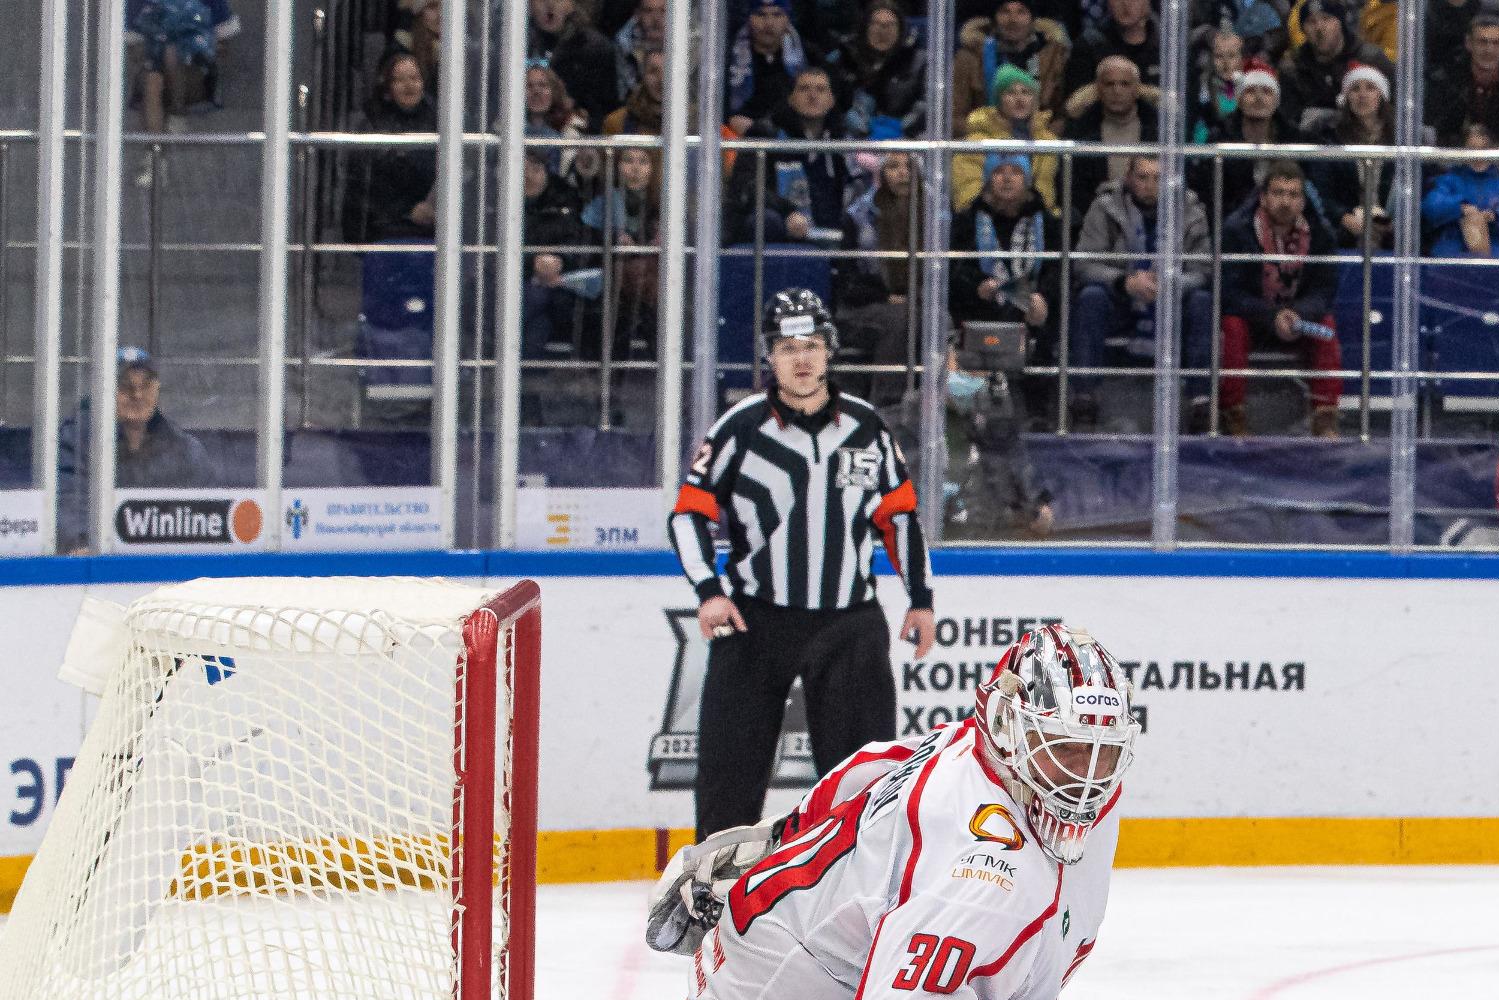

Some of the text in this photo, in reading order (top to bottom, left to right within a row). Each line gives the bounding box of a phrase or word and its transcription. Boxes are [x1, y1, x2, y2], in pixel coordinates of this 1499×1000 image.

[124, 506, 222, 537] Winline
[595, 527, 640, 544] ЭПМ
[1076, 694, 1120, 707] согаз
[892, 933, 976, 994] 30
